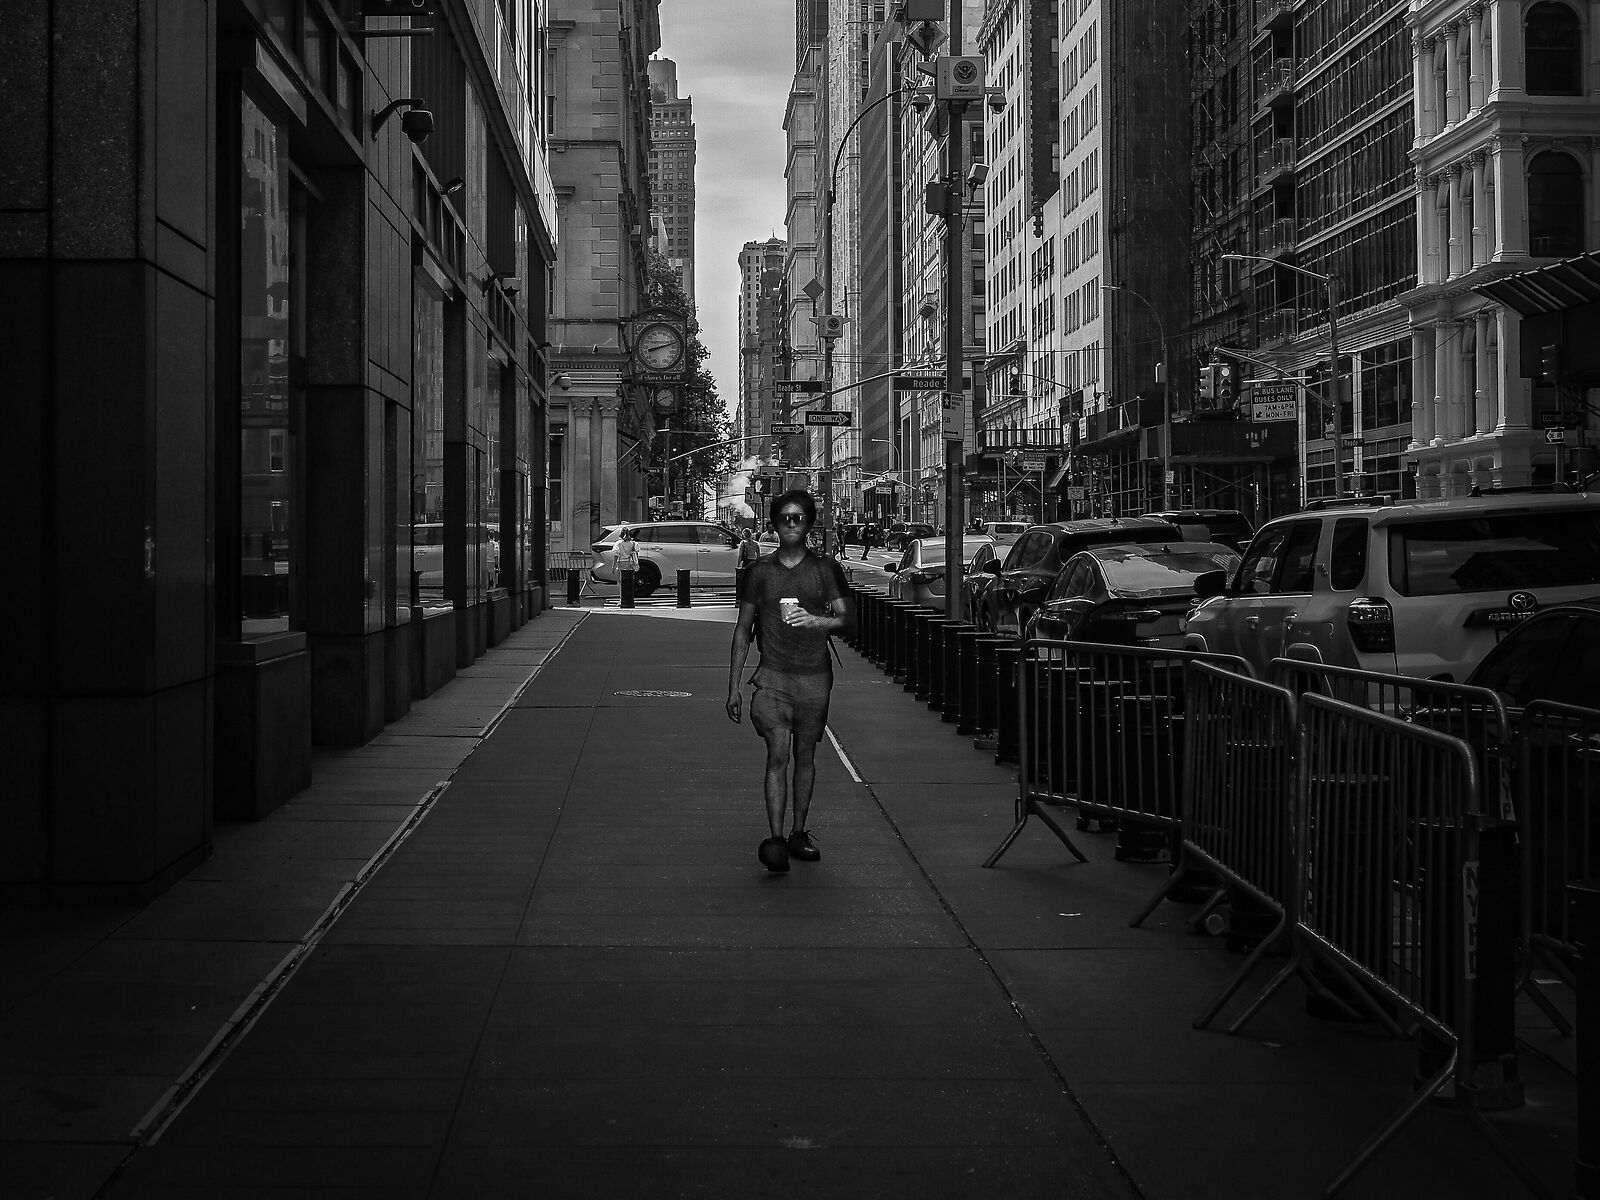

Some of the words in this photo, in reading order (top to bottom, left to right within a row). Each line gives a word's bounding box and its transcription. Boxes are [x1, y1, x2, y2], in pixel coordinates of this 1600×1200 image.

[777, 384, 794, 392] Reade
[913, 379, 940, 388] Reade
[1262, 387, 1274, 395] BUS
[1276, 386, 1294, 394] LANE
